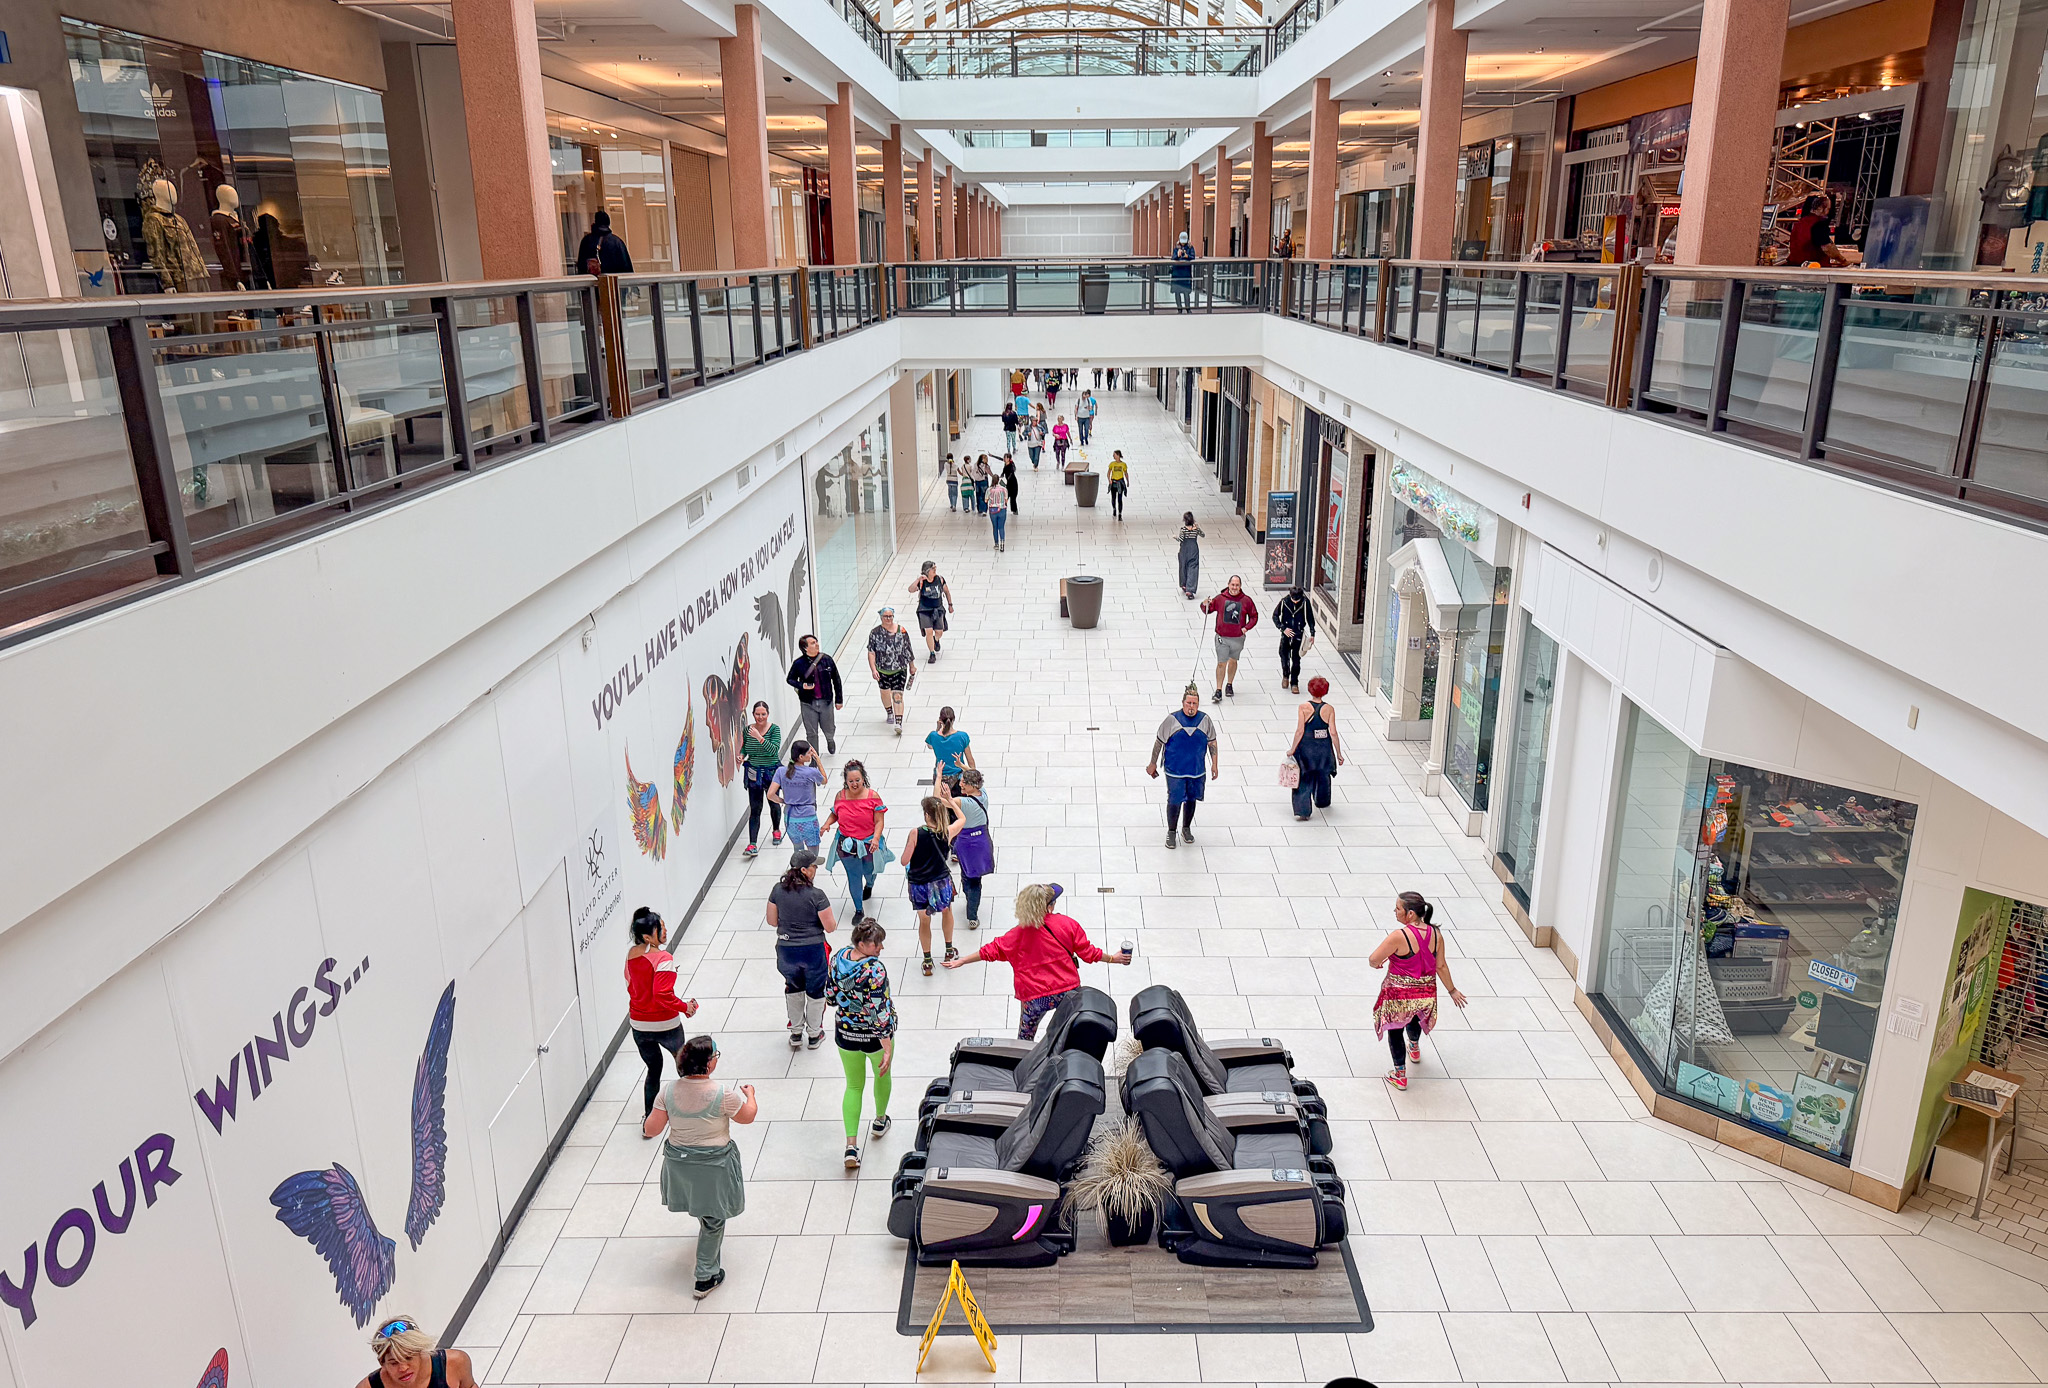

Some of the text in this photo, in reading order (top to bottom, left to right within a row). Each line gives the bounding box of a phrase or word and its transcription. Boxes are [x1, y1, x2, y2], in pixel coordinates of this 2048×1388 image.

[144, 108, 177, 117] adidas
[592, 512, 794, 731] YOU'LL HAVE NO IDEA HOW FAR YOU CAN FLY!
[578, 897, 597, 927] LLOYD
[1812, 962, 1840, 980] CLOSED
[1758, 1097, 1776, 1106] WE'RE
[1758, 1102, 1776, 1111] GOING
[1752, 1104, 1780, 1118] ELECTRIC!
[0, 1132, 183, 1331] YOUR
